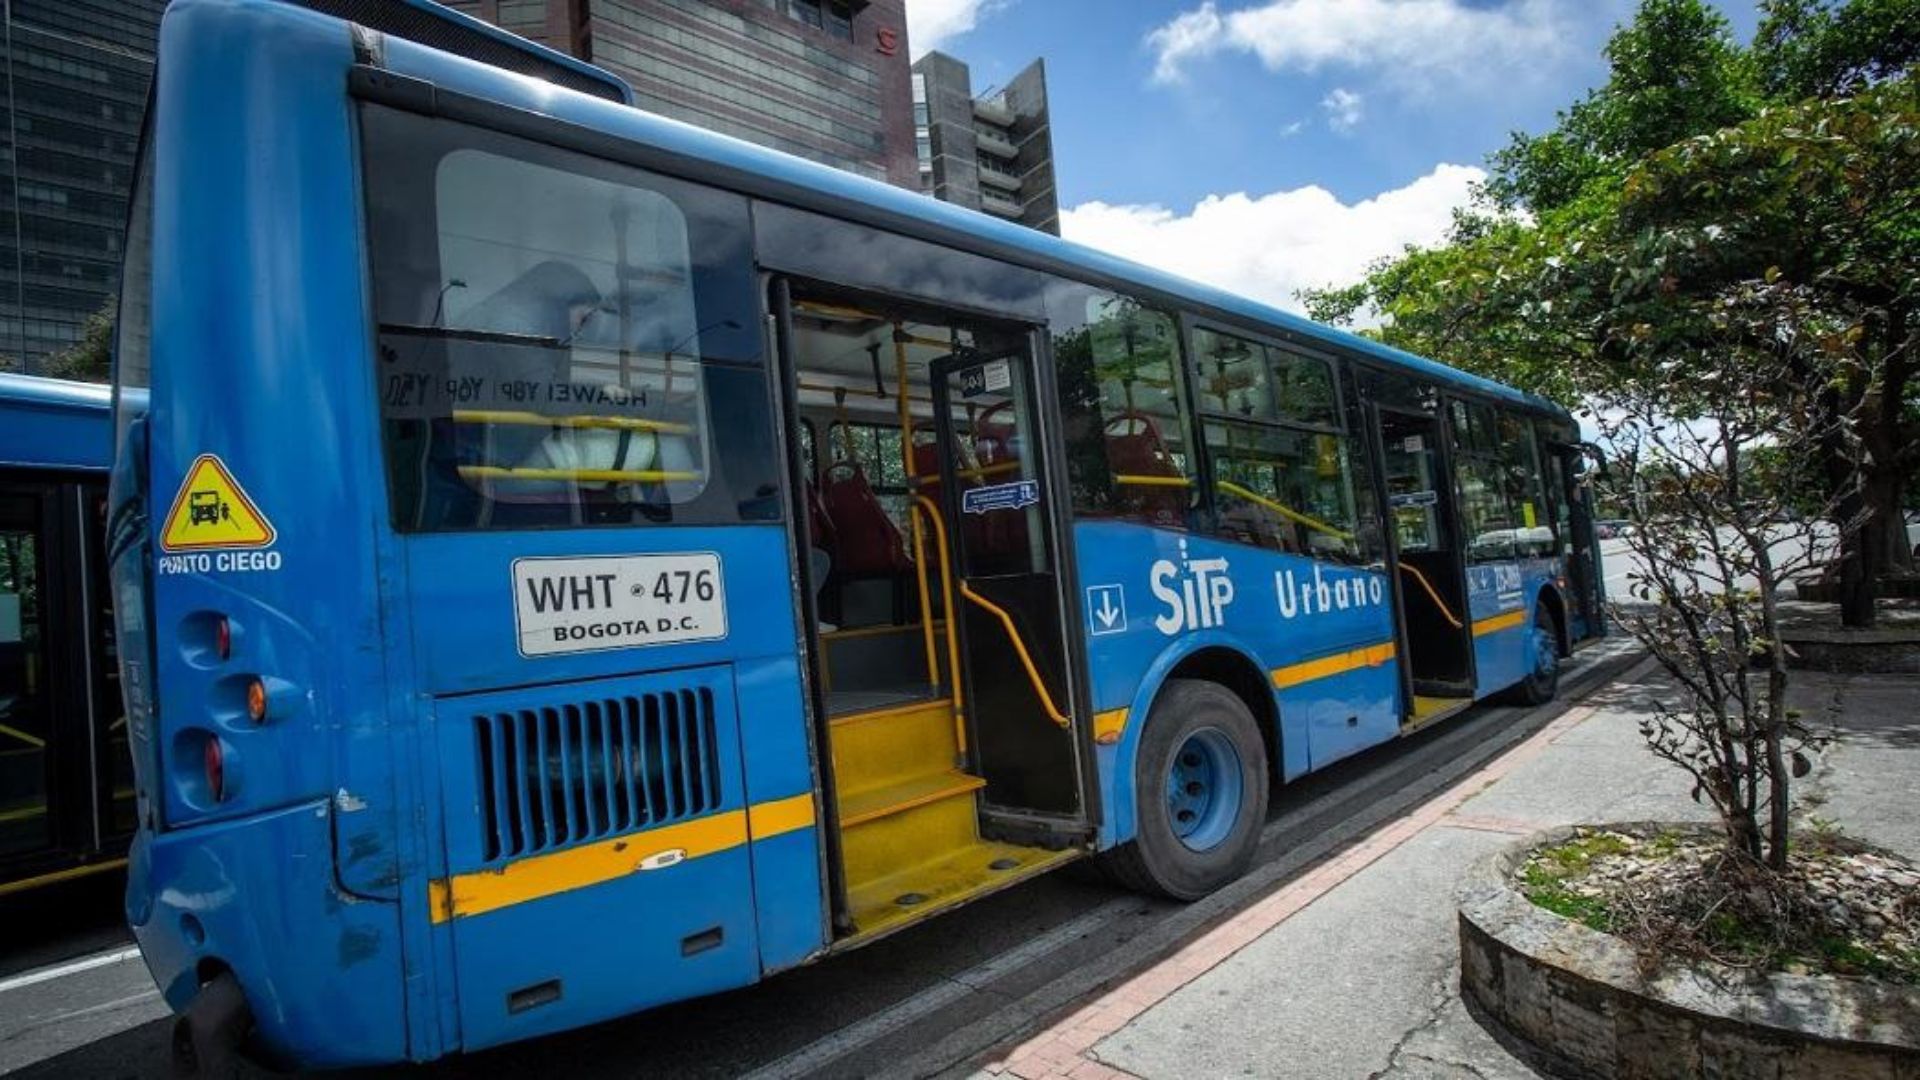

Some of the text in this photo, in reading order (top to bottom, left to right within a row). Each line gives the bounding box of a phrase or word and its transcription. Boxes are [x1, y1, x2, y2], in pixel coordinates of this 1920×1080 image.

[159, 551, 281, 574] PUNTO CIEGO
[527, 569, 714, 613] WHT 476
[1275, 564, 1382, 618] Urbano
[554, 616, 699, 641] BOGOTA D.C.
